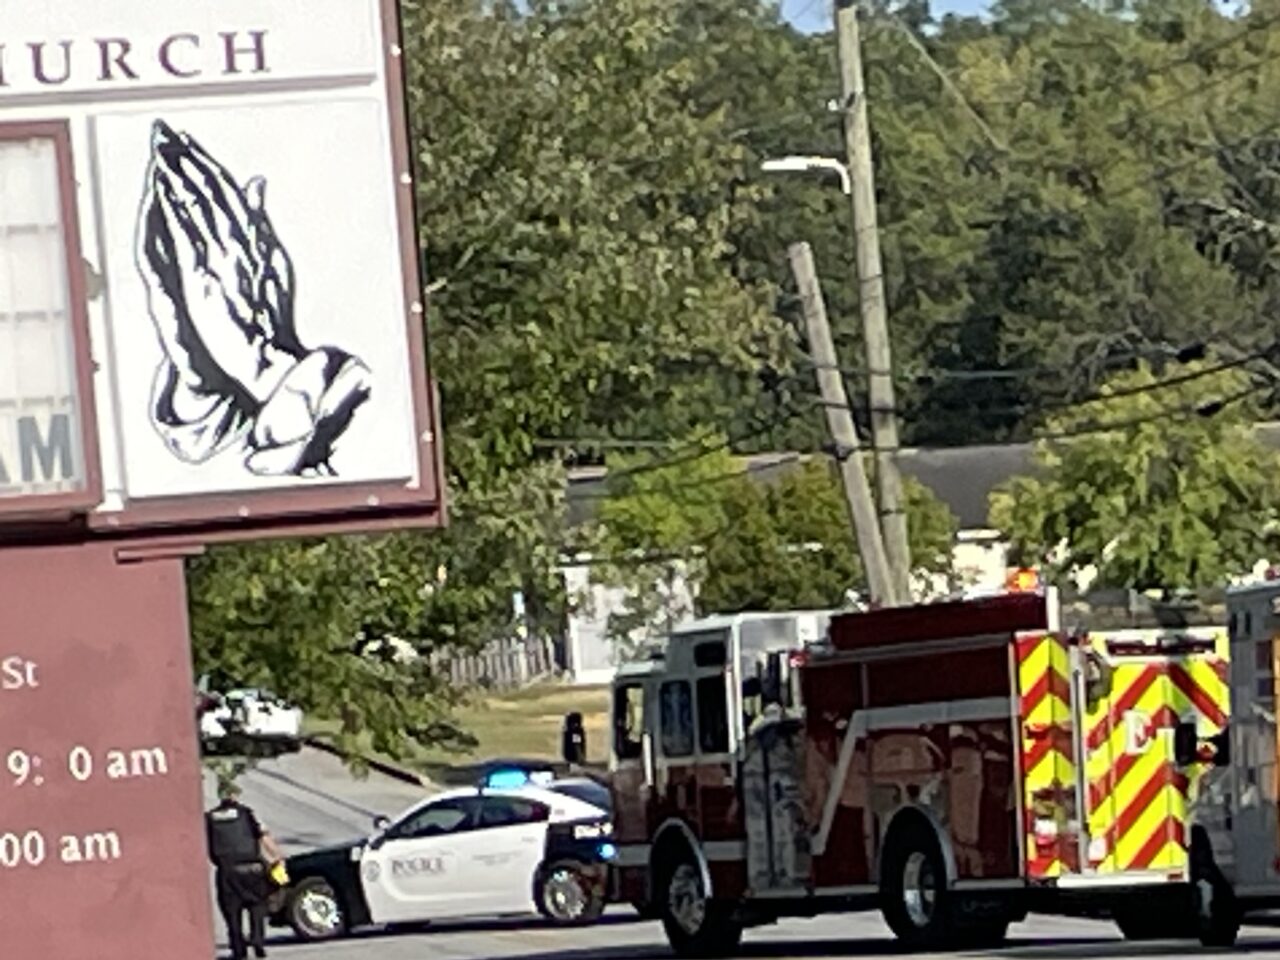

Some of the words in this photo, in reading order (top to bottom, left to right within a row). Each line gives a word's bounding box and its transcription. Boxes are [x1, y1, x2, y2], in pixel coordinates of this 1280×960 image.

[0, 29, 272, 87] URCH
[0, 414, 74, 484] M
[1, 655, 39, 690] St
[106, 747, 168, 778] am
[59, 831, 121, 863] am
